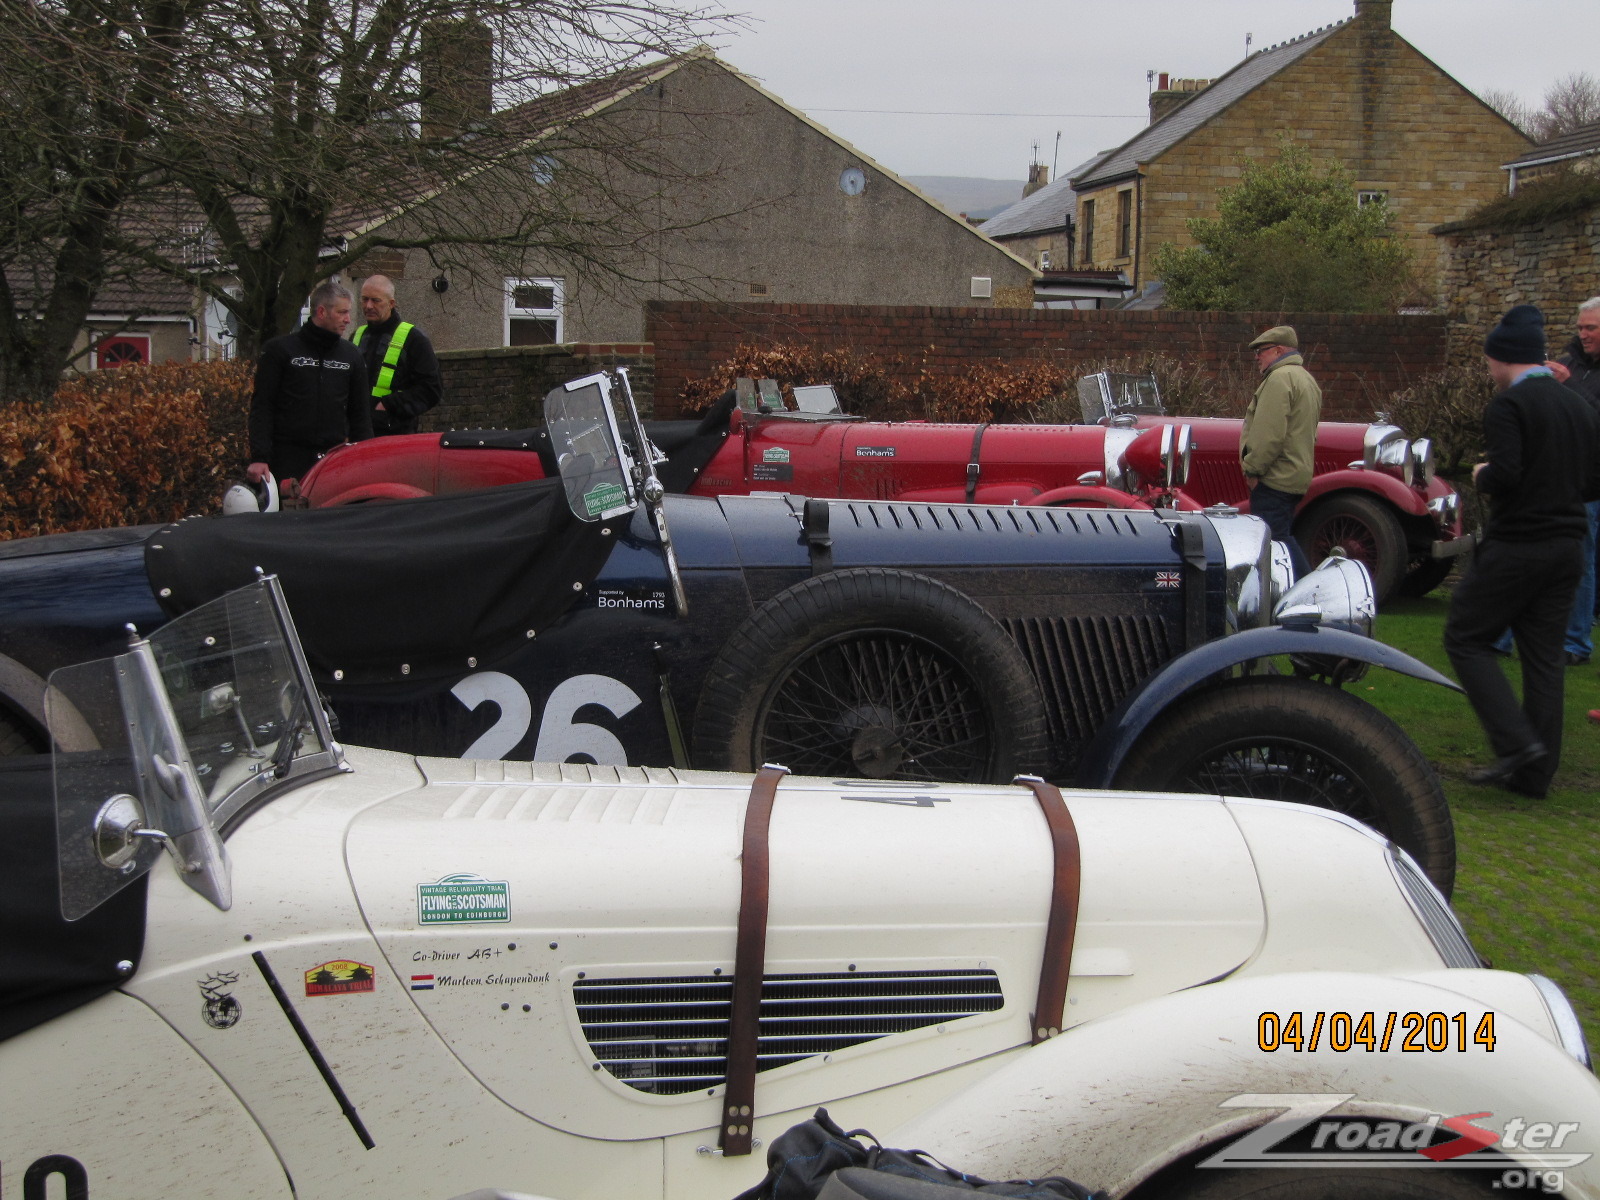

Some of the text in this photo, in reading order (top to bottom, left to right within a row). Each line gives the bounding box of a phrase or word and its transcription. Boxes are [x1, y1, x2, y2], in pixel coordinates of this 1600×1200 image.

[598, 596, 665, 609] Bonhams
[450, 671, 643, 767] 26
[422, 894, 453, 910] FLYING
[457, 893, 506, 909] SCOTSMAN
[412, 950, 460, 961] Co-driver
[437, 972, 550, 987] Marleen Schapendonk
